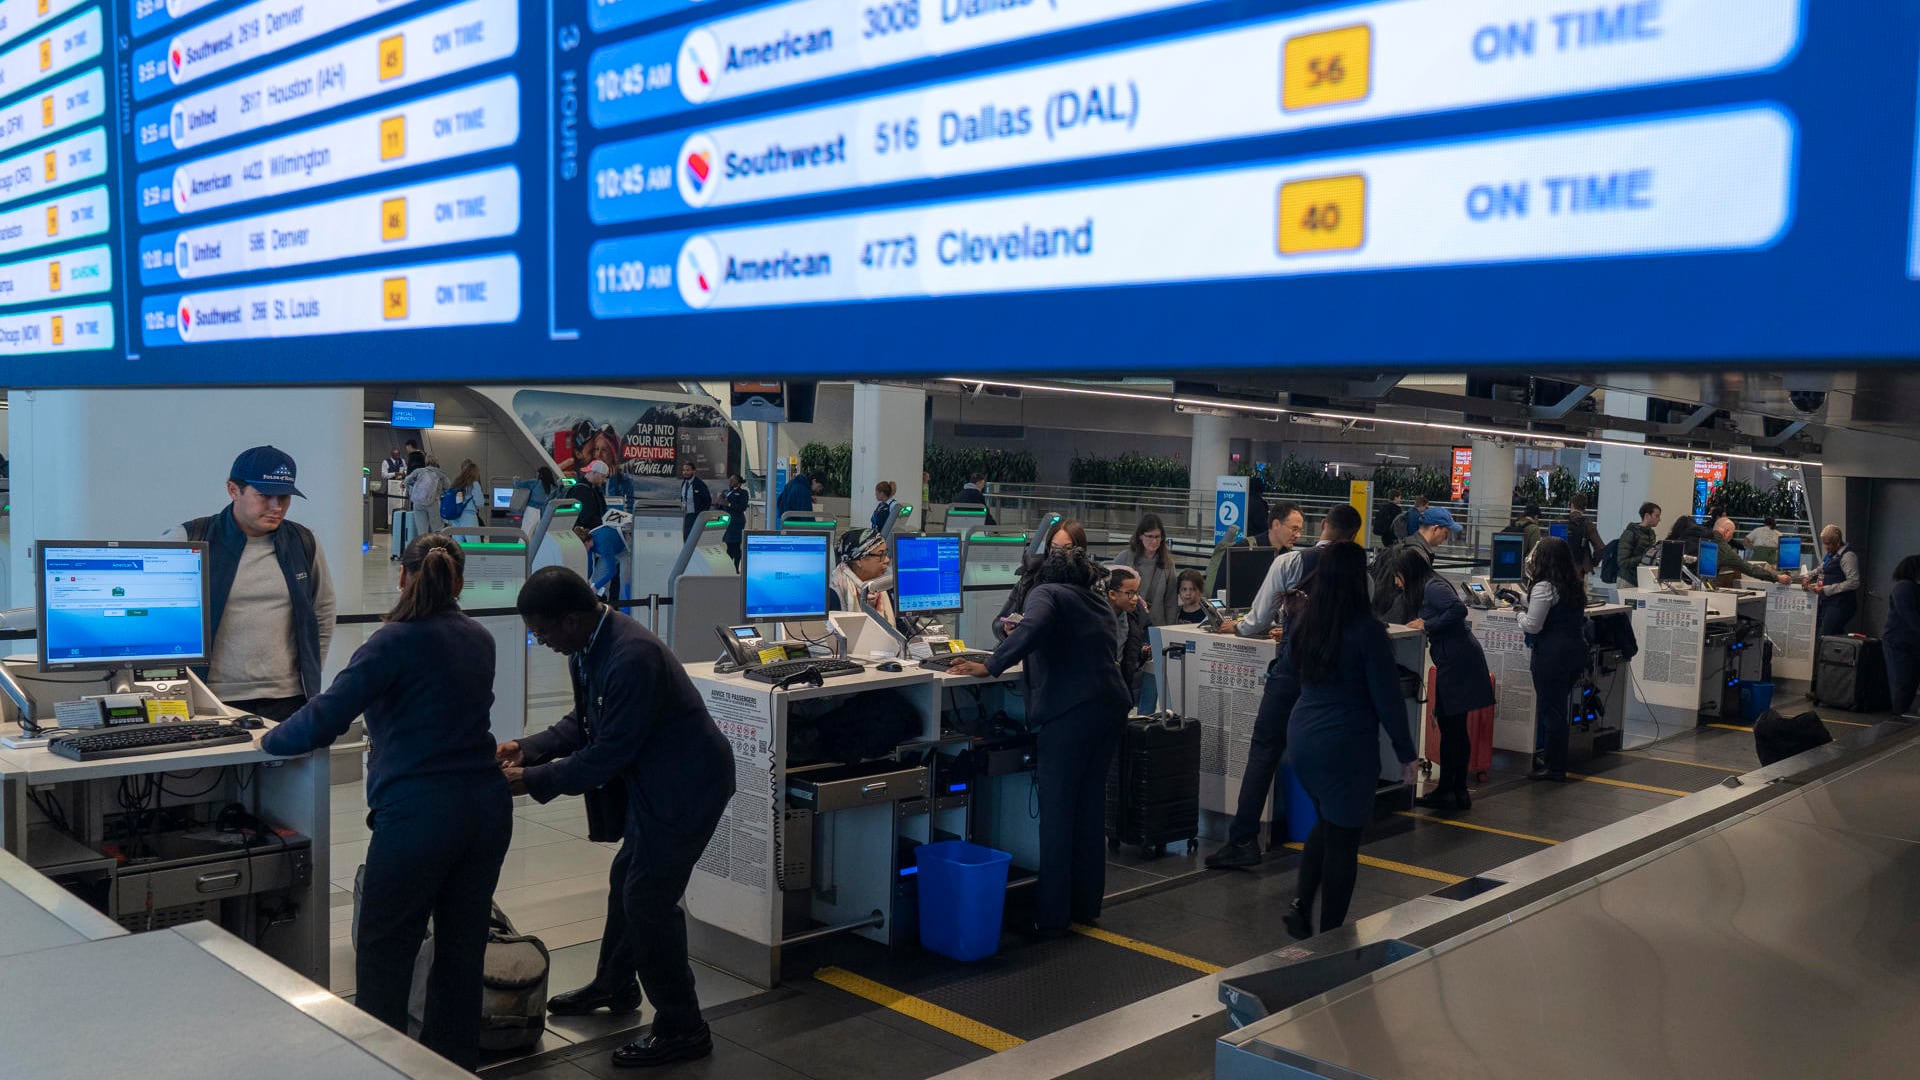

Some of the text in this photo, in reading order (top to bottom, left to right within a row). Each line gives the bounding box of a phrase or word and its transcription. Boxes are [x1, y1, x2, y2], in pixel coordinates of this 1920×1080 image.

[185, 31, 233, 65] Southwest
[265, 5, 305, 35] Denver
[558, 23, 580, 51] 3
[596, 62, 645, 102] 10:45
[646, 62, 673, 91] AM
[725, 26, 834, 71] American
[862, 0, 920, 38] 3008
[187, 104, 217, 131] United
[267, 78, 314, 106] Houston
[432, 32, 452, 54] ON
[454, 20, 485, 47] TIME
[596, 0, 1665, 200] 10:45 AM Southwest 516 Dallas (DAL) 56 ON TIME
[191, 172, 232, 195] American
[269, 147, 331, 176] Wilmington
[433, 117, 453, 138] ON
[455, 106, 486, 132] TIME
[191, 242, 221, 262] United
[271, 228, 310, 250] Denver
[434, 203, 454, 223] ON
[456, 194, 487, 219] TIME
[596, 167, 1656, 294] 11:00 AM American 4773 Cleveland 40 ON TIME
[194, 305, 242, 327] Southwest
[290, 297, 320, 319] Louis
[436, 285, 454, 305] ON
[456, 281, 487, 303] TIME
[624, 446, 674, 459] ADVENTURE
[627, 434, 652, 446] YOUR
[653, 436, 674, 447] NEXT
[637, 423, 675, 436] TAP INTO
[634, 460, 674, 475] TRAVEL ON
[1223, 505, 1232, 521] 2
